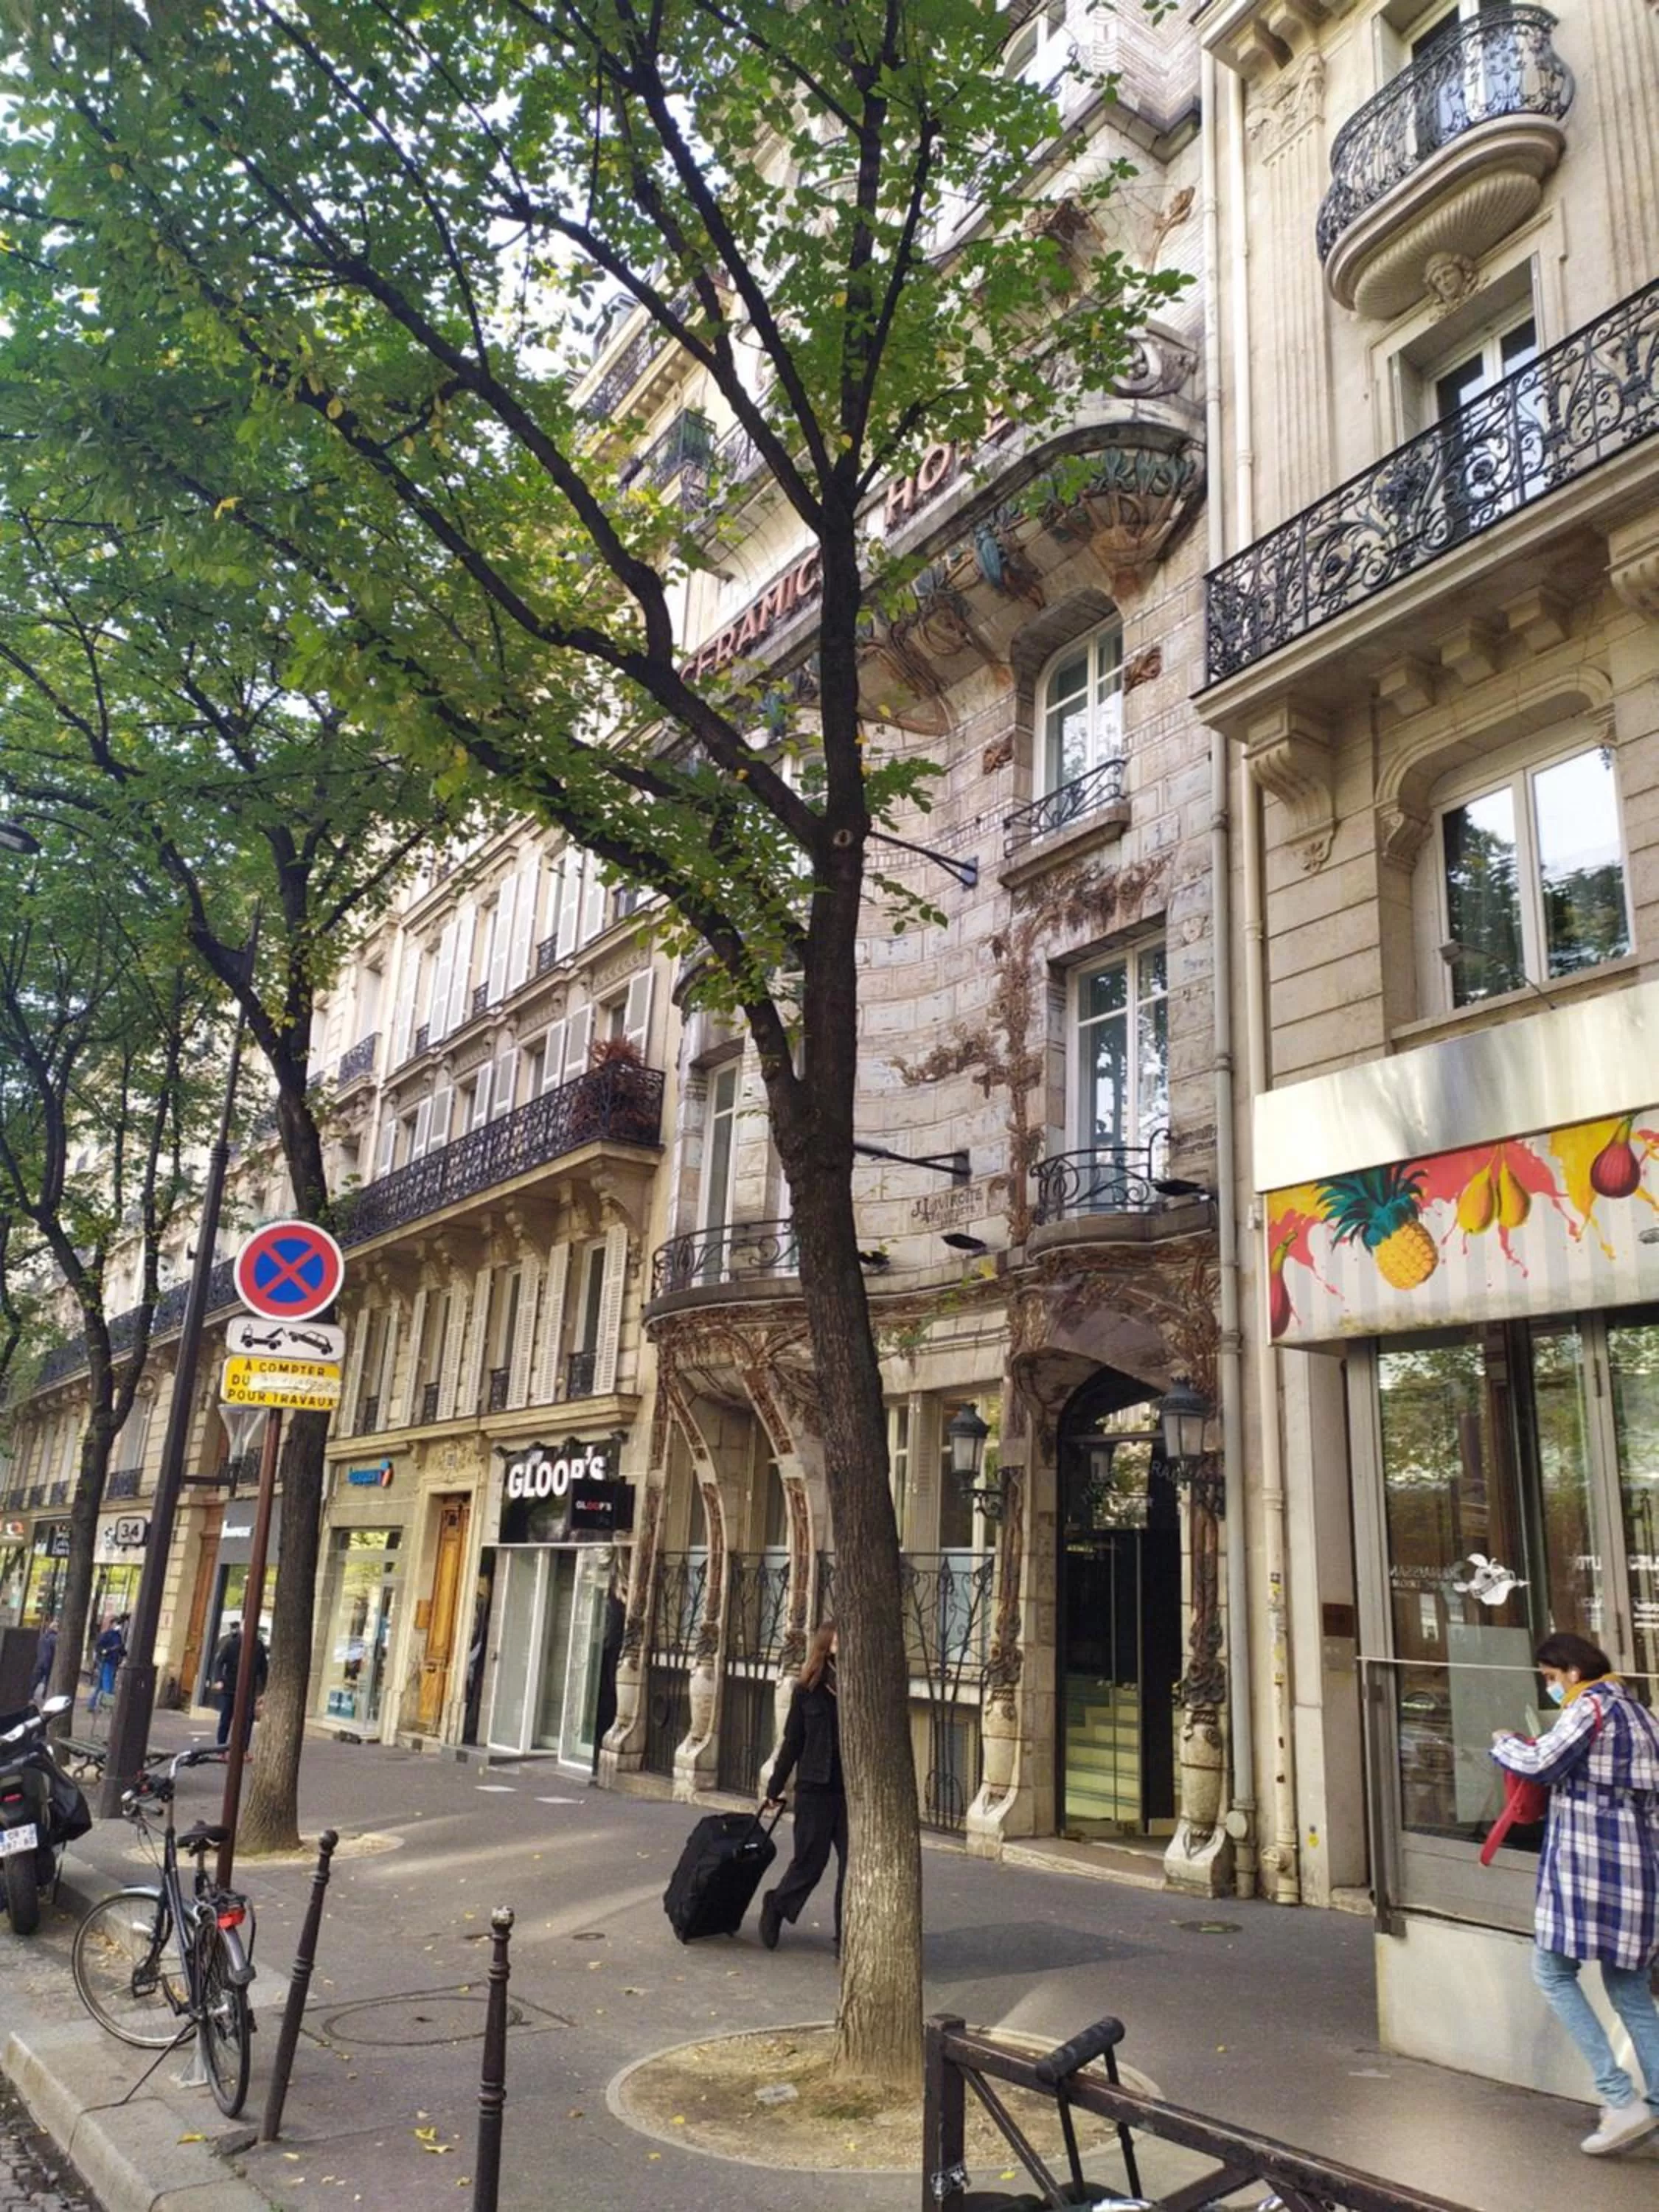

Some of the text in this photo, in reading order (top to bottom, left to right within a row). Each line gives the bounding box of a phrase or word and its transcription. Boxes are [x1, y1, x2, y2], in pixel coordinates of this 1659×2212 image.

[258, 1361, 326, 1377] COMPTER
[231, 1373, 251, 1386] DU
[226, 1388, 334, 1408] POUR TRAVAUX
[119, 1523, 140, 1538] 34
